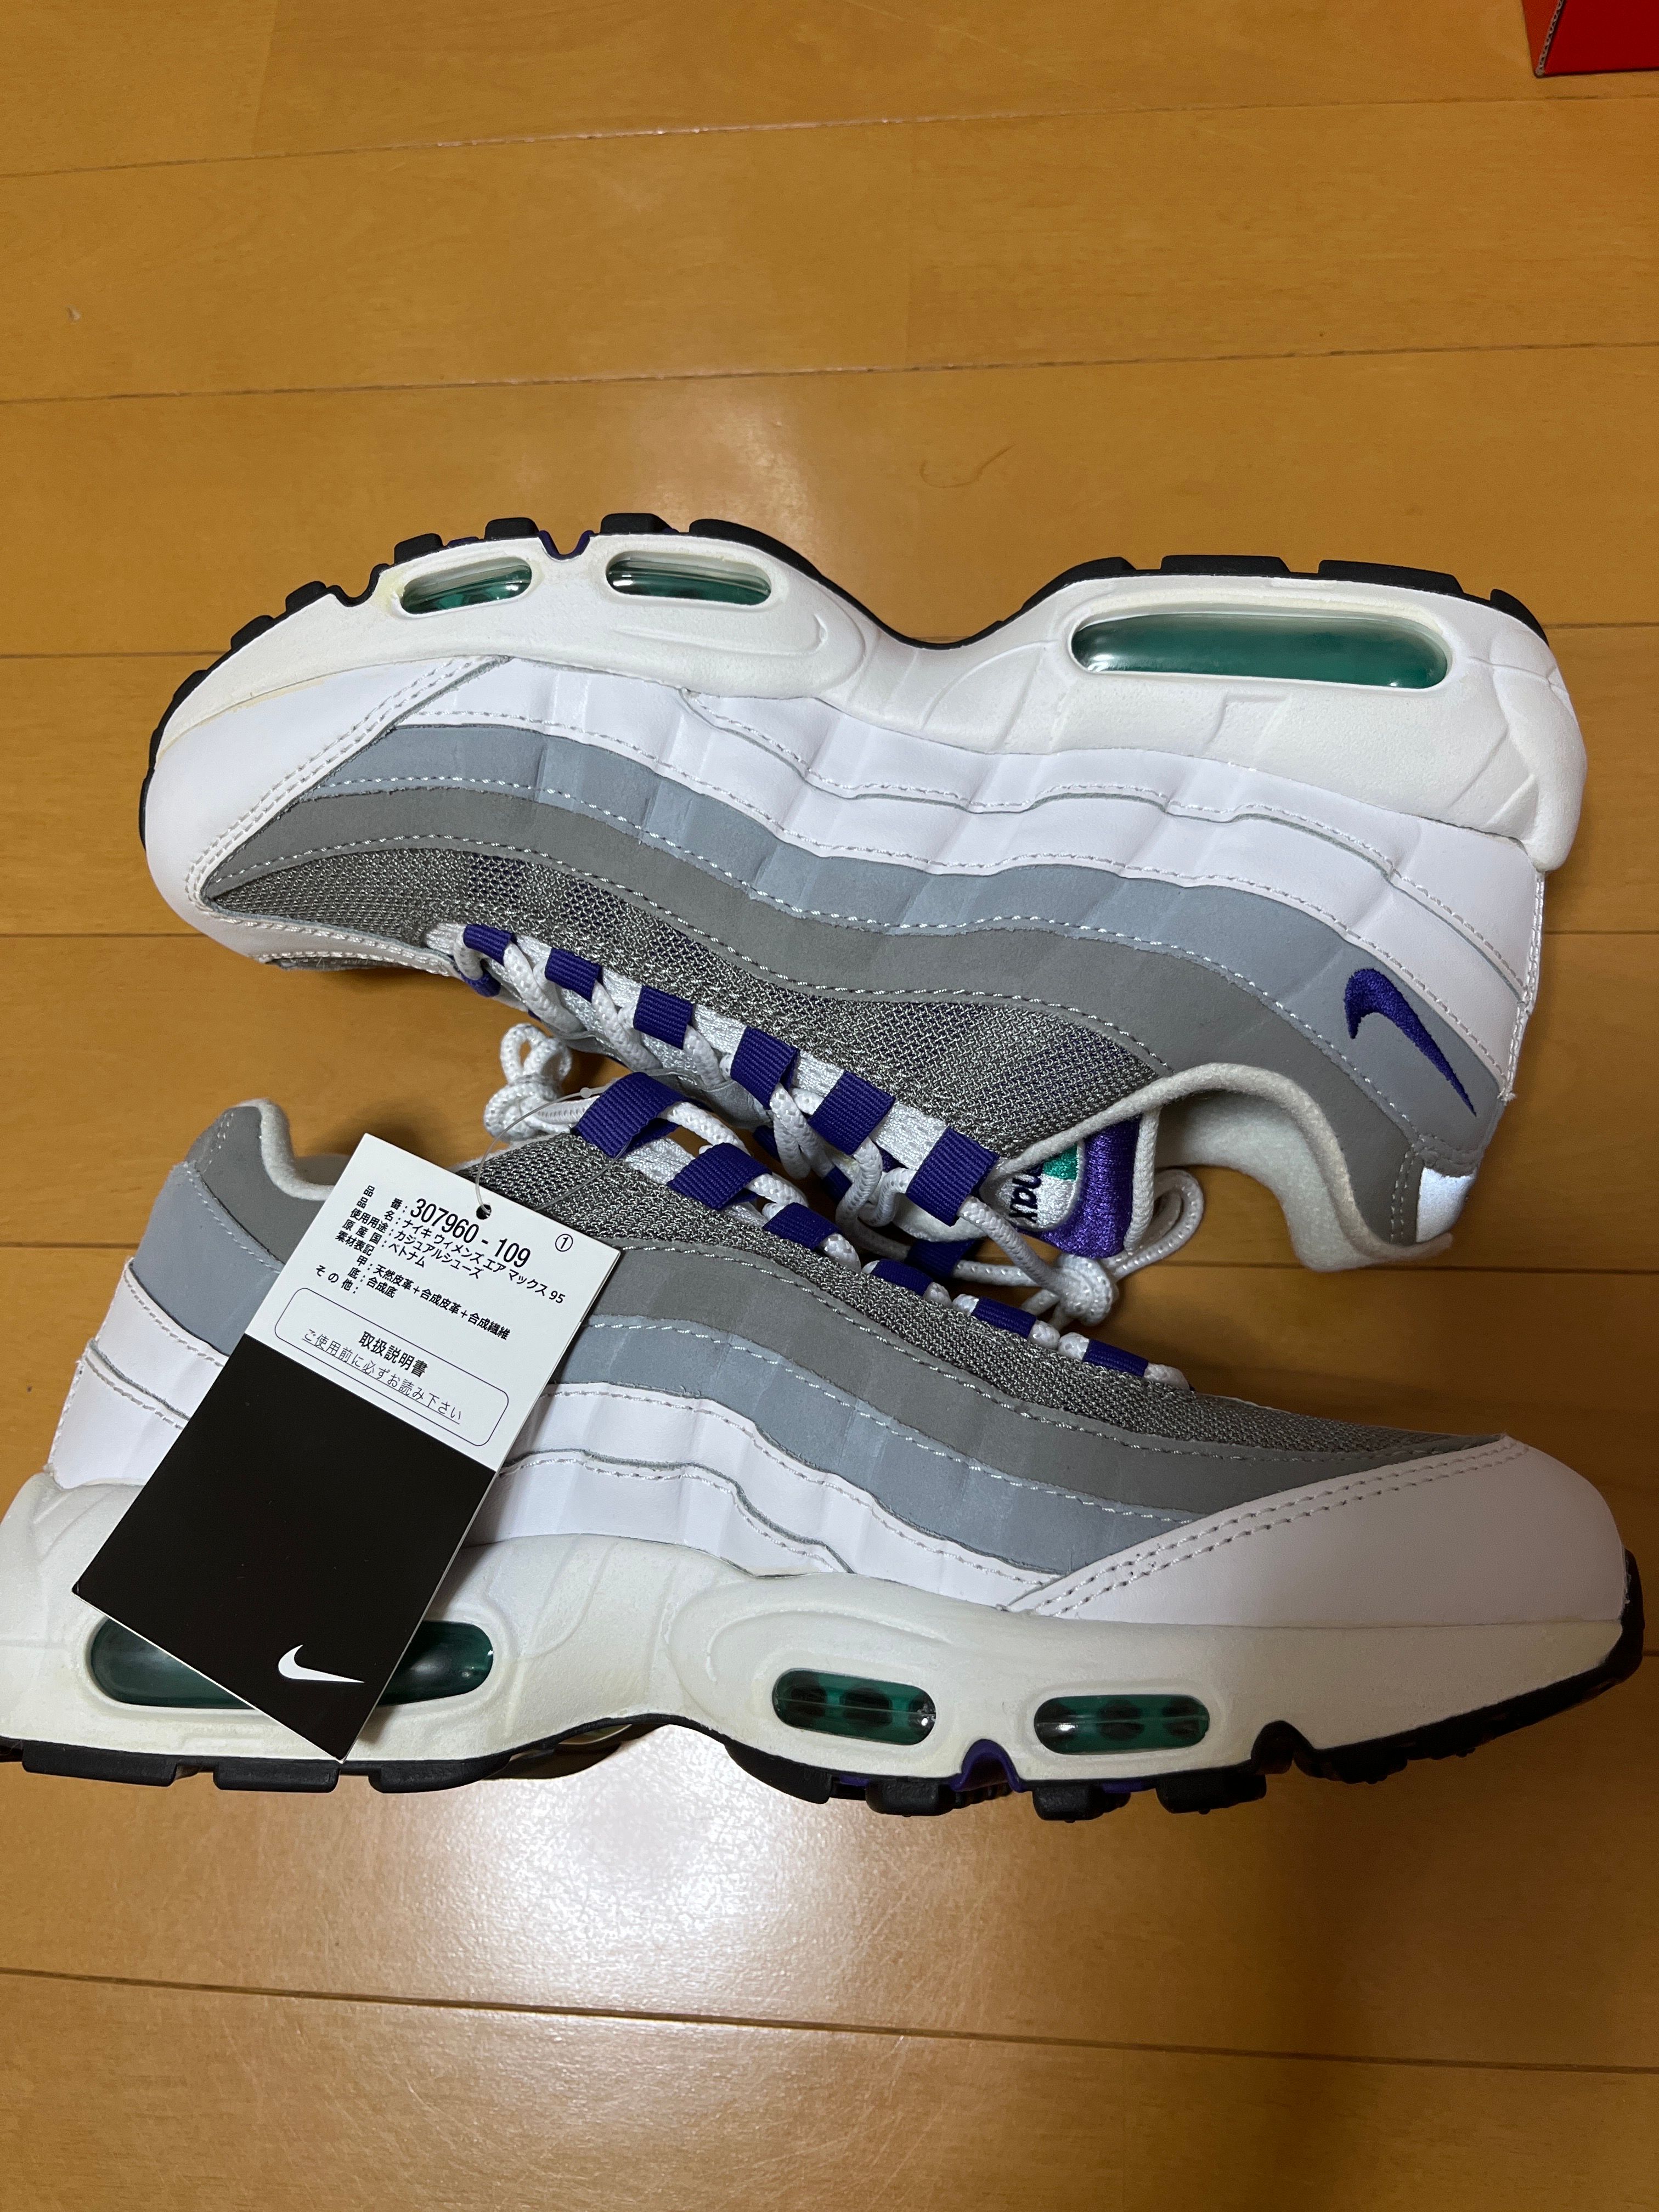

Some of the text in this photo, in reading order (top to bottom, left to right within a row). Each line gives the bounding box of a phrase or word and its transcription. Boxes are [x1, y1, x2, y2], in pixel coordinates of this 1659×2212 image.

[335, 1231, 375, 1256] 素材表記
[495, 1239, 531, 1267] 109
[549, 1291, 565, 1304] 95
[359, 1331, 427, 1378] 取扱説明書
[305, 1329, 461, 1419] ご使用前に必ずお読み下さい
